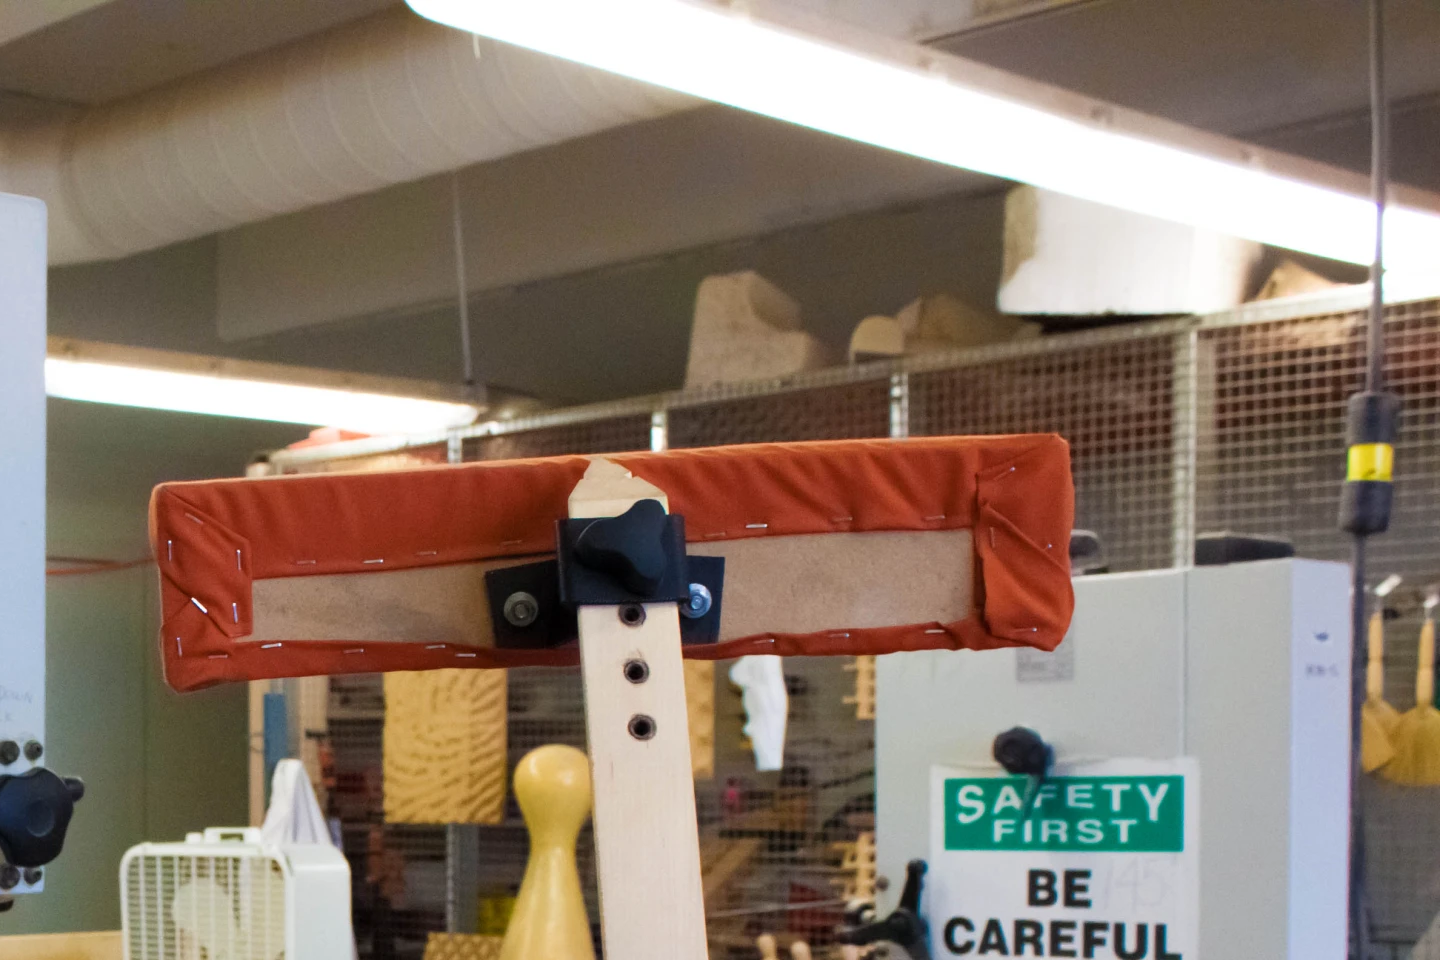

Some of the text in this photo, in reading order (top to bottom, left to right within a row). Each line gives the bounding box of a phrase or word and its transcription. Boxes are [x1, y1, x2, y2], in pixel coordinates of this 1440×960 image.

[956, 783, 1170, 823] SAFETY
[993, 819, 1138, 844] FIRST
[1027, 869, 1093, 908] BE
